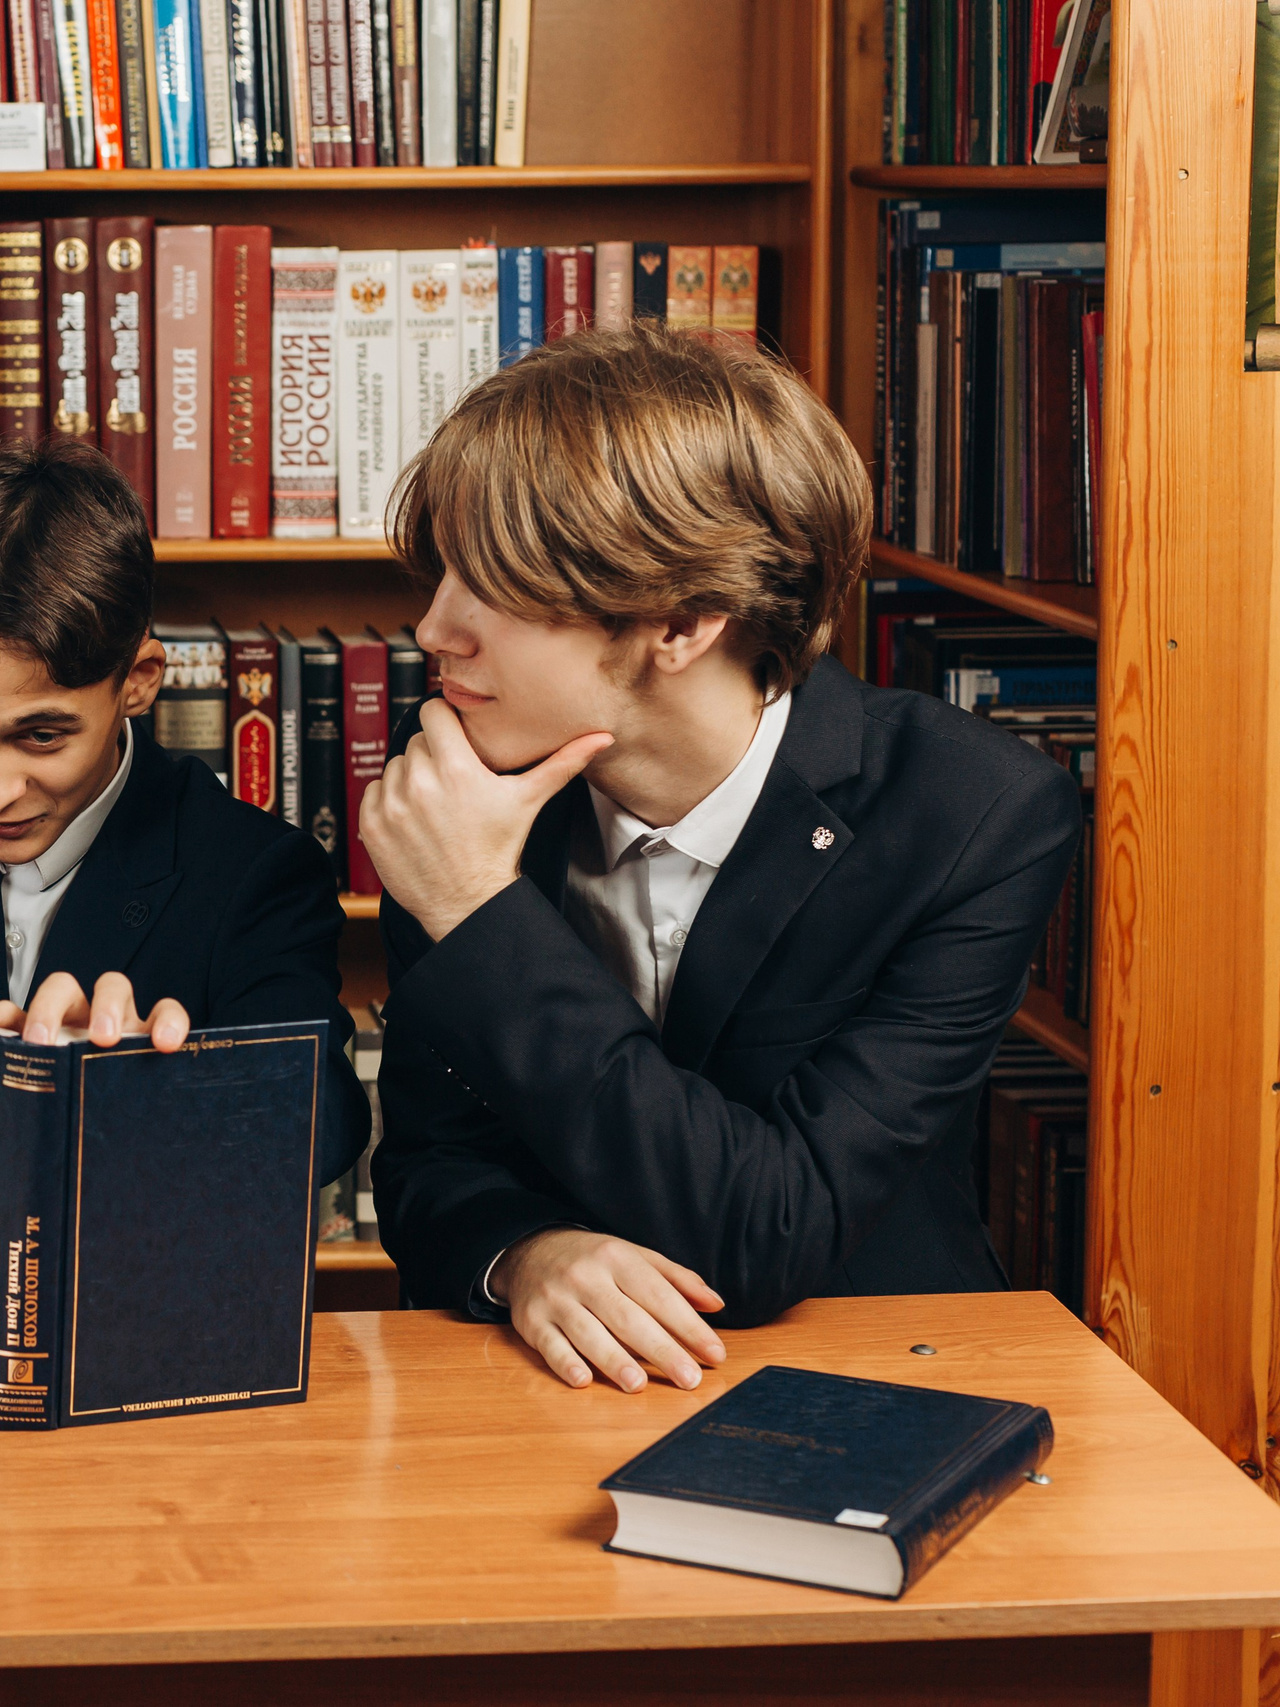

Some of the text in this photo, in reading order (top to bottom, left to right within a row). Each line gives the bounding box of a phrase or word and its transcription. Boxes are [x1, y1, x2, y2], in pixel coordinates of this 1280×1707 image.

[207, 65, 227, 150] Russian
[172, 265, 185, 320] ВЕЛИКАЯ
[185, 270, 198, 315] СУДЬБА
[173, 347, 197, 451] РОССИЯ
[228, 375, 254, 466] РОССИЯ
[279, 334, 303, 467] ИСТОРИЯ
[306, 334, 330, 467] РОССИИ
[356, 342, 369, 513] ИСТОРИЯ ГОСУДАРСТВА
[372, 372, 384, 473] РОССИЙСКОГО
[282, 709, 298, 778] РОДНОЕ
[8, 1239, 23, 1295] Тихий
[23, 1215, 40, 1349] М. А. ШОЛОХОВ
[5, 1295, 21, 1330] Дон
[122, 1390, 251, 1413] ПУШКИНСКАЯ БИБЛИОТЕКА
